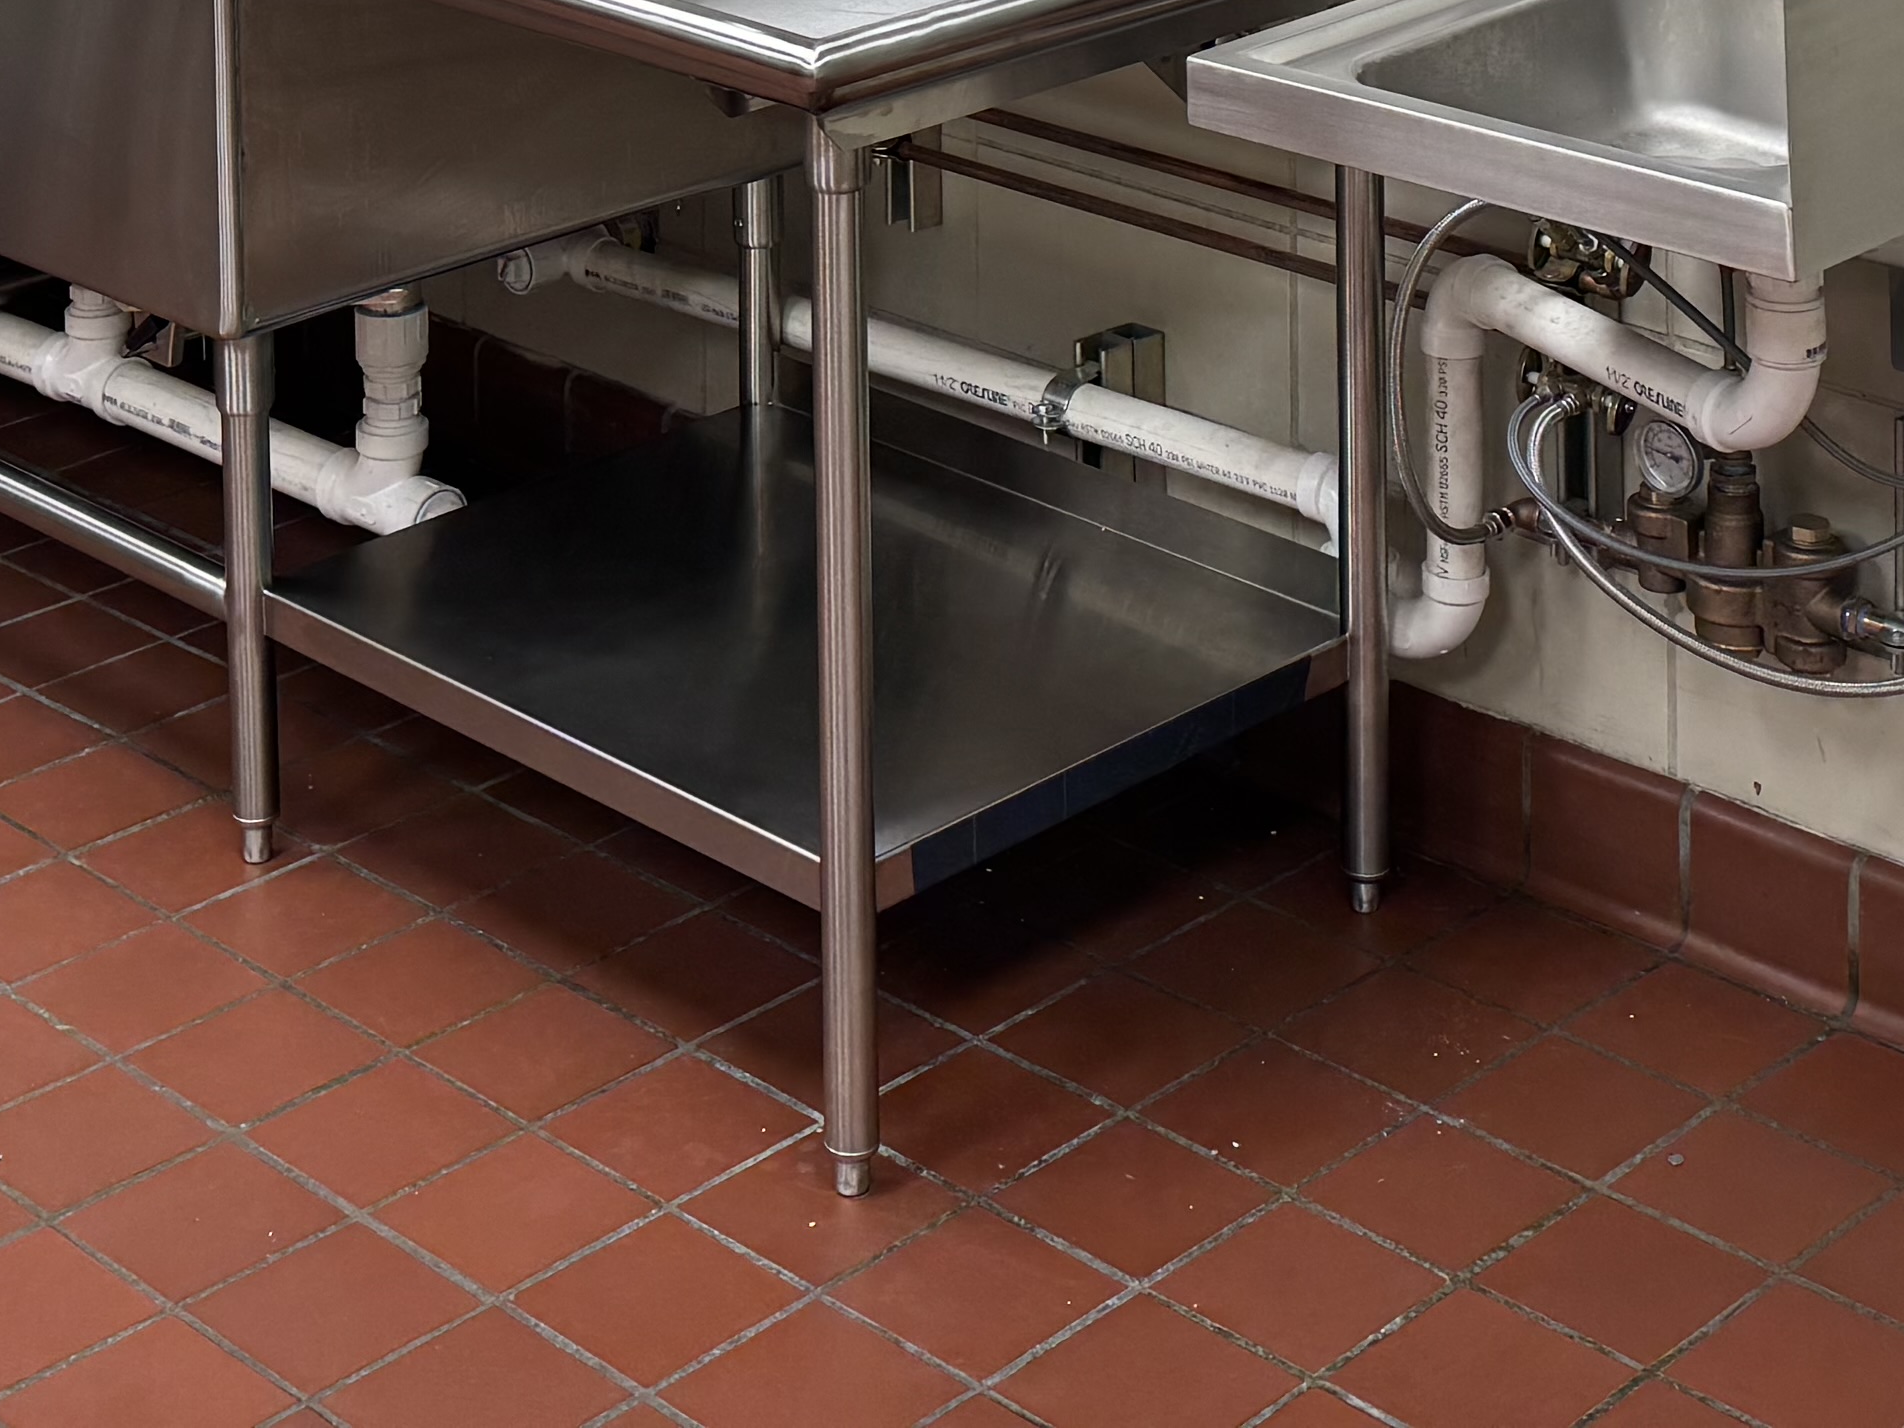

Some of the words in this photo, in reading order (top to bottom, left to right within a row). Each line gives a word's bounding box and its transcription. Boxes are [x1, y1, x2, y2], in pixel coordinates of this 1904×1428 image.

[1434, 400, 1449, 420] 40
[1125, 433, 1147, 451] SCH
[1435, 422, 1449, 453] SCH
